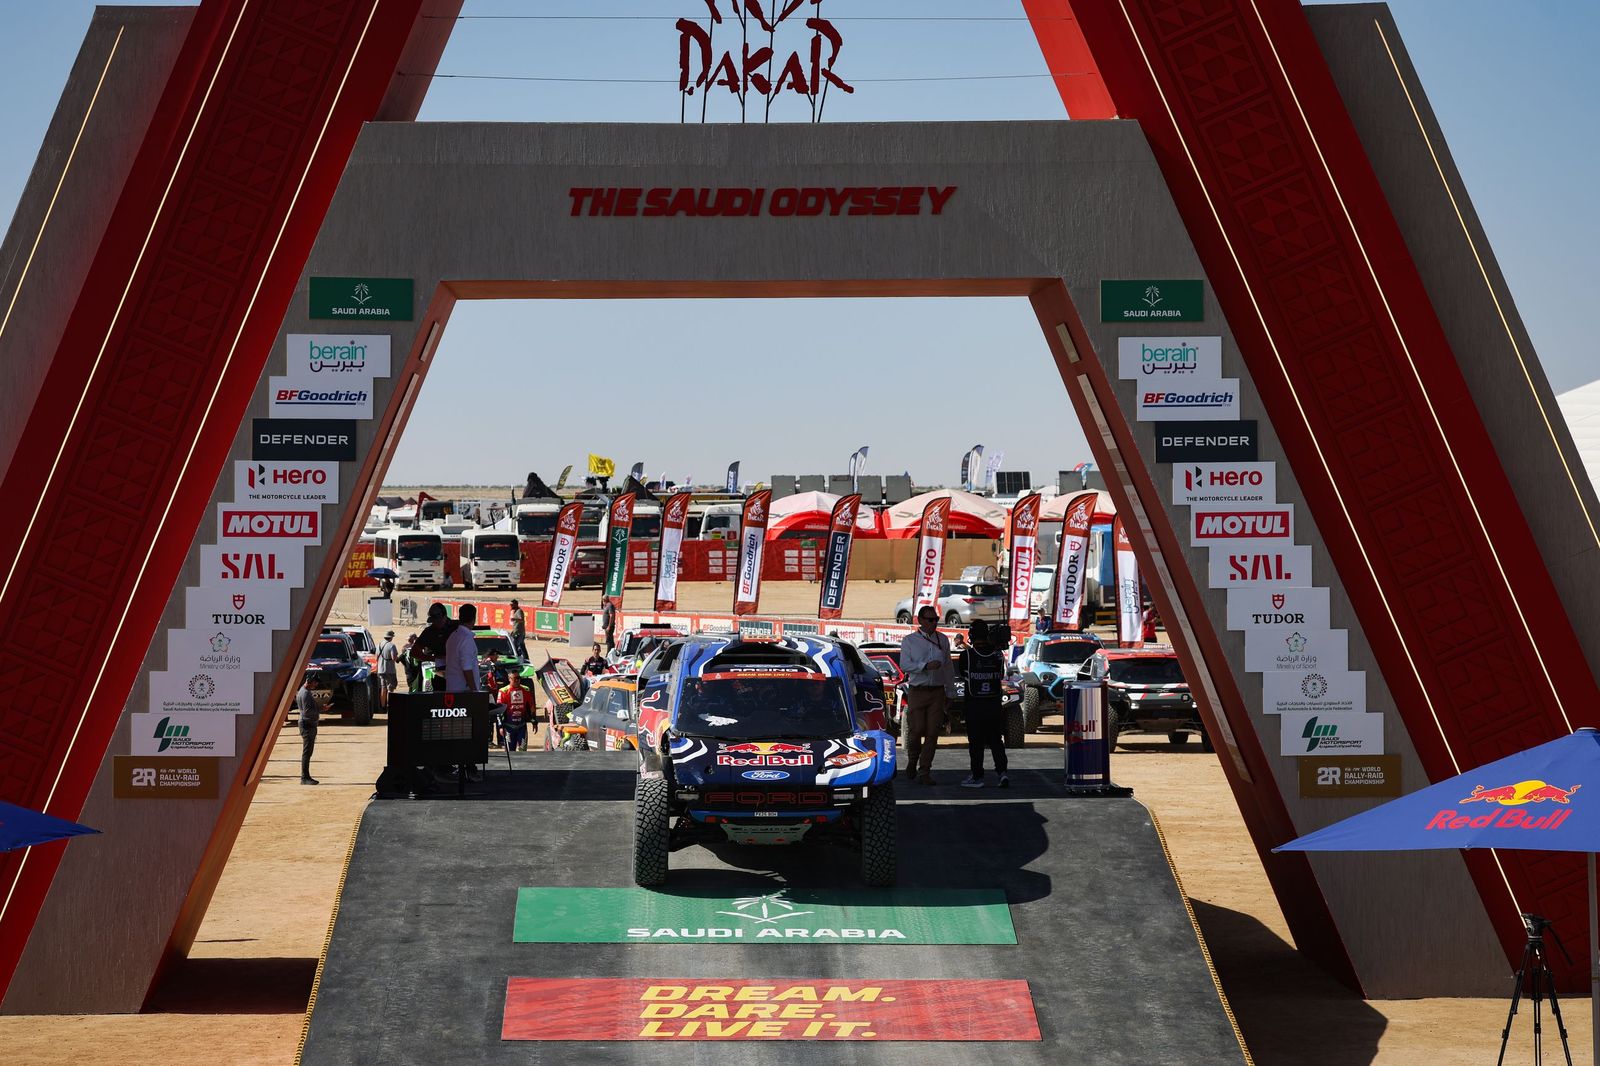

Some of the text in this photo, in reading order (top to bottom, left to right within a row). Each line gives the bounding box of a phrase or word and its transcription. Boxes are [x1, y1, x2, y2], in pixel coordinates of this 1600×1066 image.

[675, 17, 855, 96] DAKAR
[568, 185, 958, 217] THE SAUDI ODYSSEY
[332, 307, 357, 315] SAUDI
[309, 340, 366, 360] berain
[1141, 342, 1197, 362] berain
[309, 360, 365, 373] بيرين
[1142, 362, 1197, 375] بيرين
[276, 390, 367, 401] BFGoodrich
[1143, 392, 1233, 404] BFGoodrich
[259, 434, 349, 445] DEFENDER
[1162, 436, 1250, 447] DEFENDER
[273, 469, 327, 485] Hero
[1210, 470, 1263, 486] Hero
[227, 515, 314, 534] MOTUL
[926, 521, 943, 532] DAKAR
[1017, 519, 1035, 529] DAKAR
[1069, 519, 1088, 530] DAKAR
[1199, 515, 1286, 534] MOTUL
[352, 552, 375, 560] EAM
[552, 548, 567, 588] TUDOR
[611, 546, 622, 592] SAUDI ARABIA
[742, 533, 756, 594] BFGoodrich
[827, 535, 846, 605] DEFENDER
[922, 548, 937, 588] Hero
[1015, 548, 1031, 607] MOTUL
[1064, 553, 1080, 606] TUDOR
[212, 614, 265, 625] TUDOR
[1252, 613, 1305, 624] TUDOR
[740, 627, 772, 635] DEFENDER
[970, 672, 993, 680] PODIUM
[981, 682, 991, 692] 8
[557, 688, 571, 701] 221
[430, 708, 467, 718] TUDOR
[717, 755, 814, 766] Red Bull
[750, 771, 782, 780] Ford
[704, 792, 828, 805] FORD
[1424, 807, 1574, 830] Red Bull
[627, 927, 907, 940] SAUDI ARABIA
[638, 985, 897, 1002] DREAM.
[638, 1003, 837, 1019] DARE.
[638, 1021, 877, 1037] LIVE IT.
